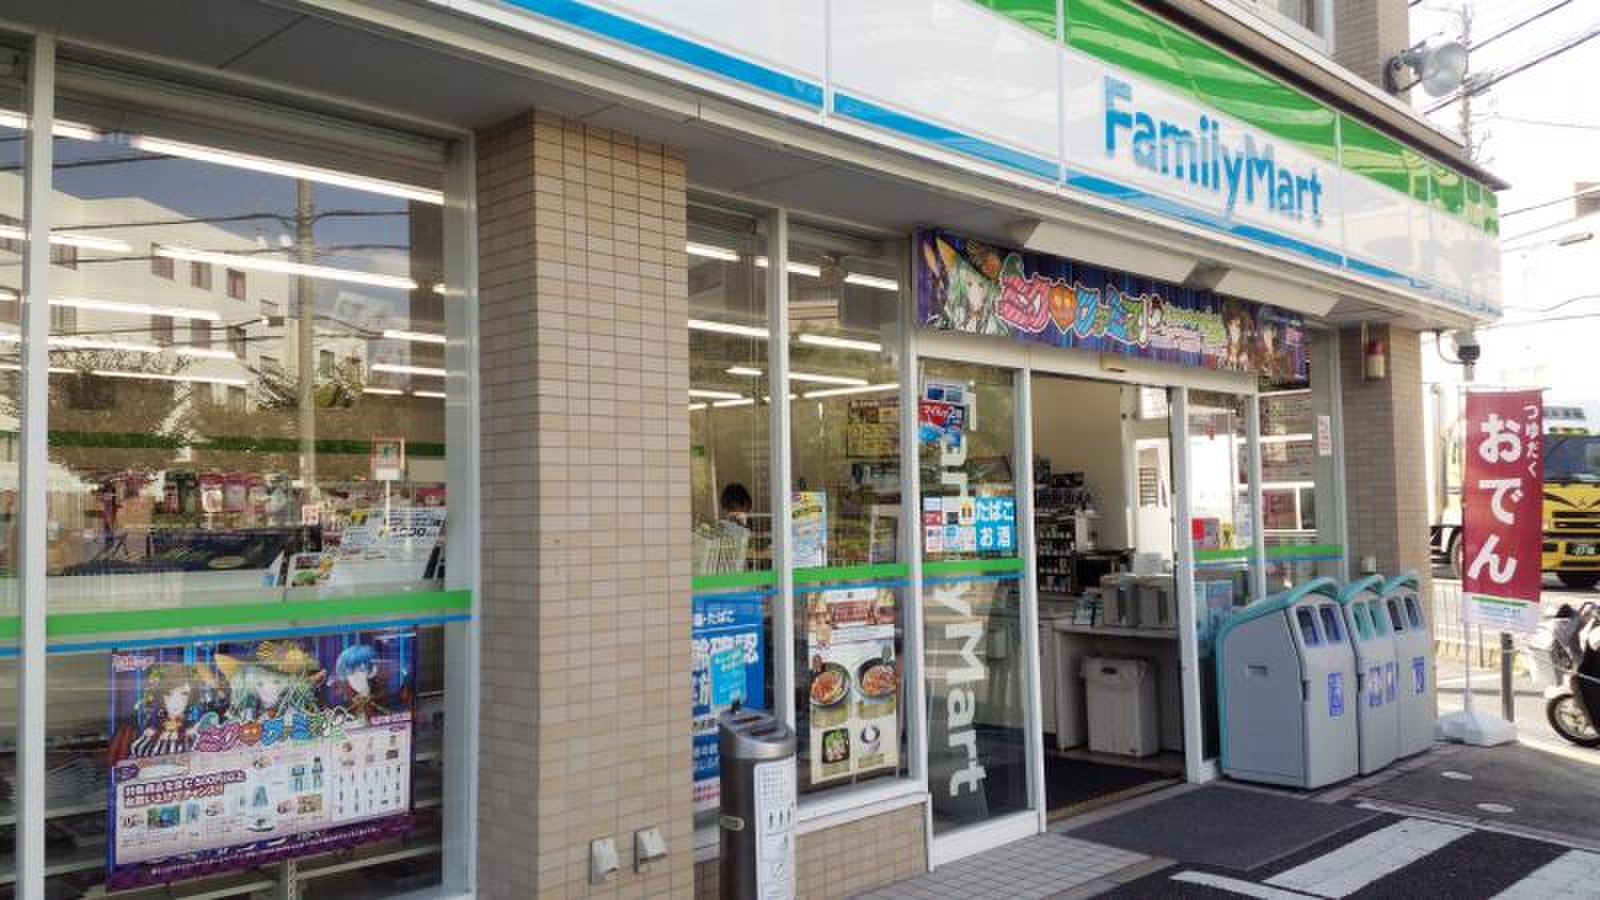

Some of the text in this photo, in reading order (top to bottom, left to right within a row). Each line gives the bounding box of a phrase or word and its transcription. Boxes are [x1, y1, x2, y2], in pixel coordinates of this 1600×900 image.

[1104, 76, 1322, 222] FamilyMart
[976, 500, 1015, 522] たばこ
[978, 526, 1011, 547] お酒
[1467, 412, 1524, 585] おでん
